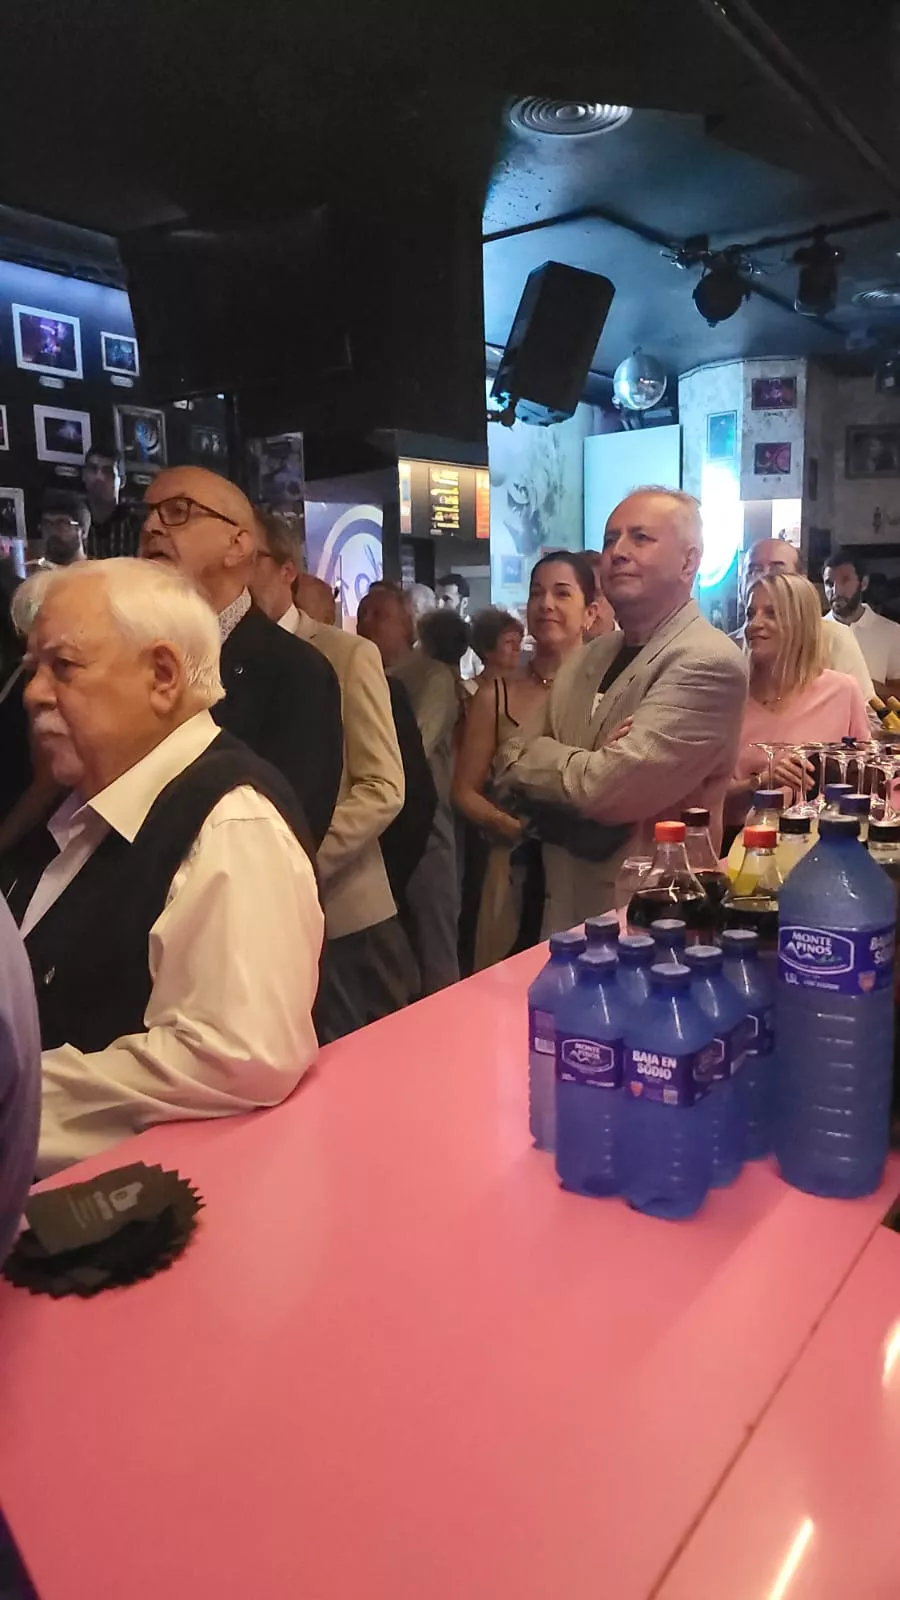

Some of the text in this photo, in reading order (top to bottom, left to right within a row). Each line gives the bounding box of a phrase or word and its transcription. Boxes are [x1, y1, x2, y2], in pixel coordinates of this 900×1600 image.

[792, 931, 832, 947] MONTE
[796, 941, 832, 956] PINOS
[575, 1042, 600, 1055] MONTE
[578, 1049, 600, 1061] PINOS
[632, 1050, 677, 1068] BAJA EN
[637, 1063, 672, 1080] SODIO
